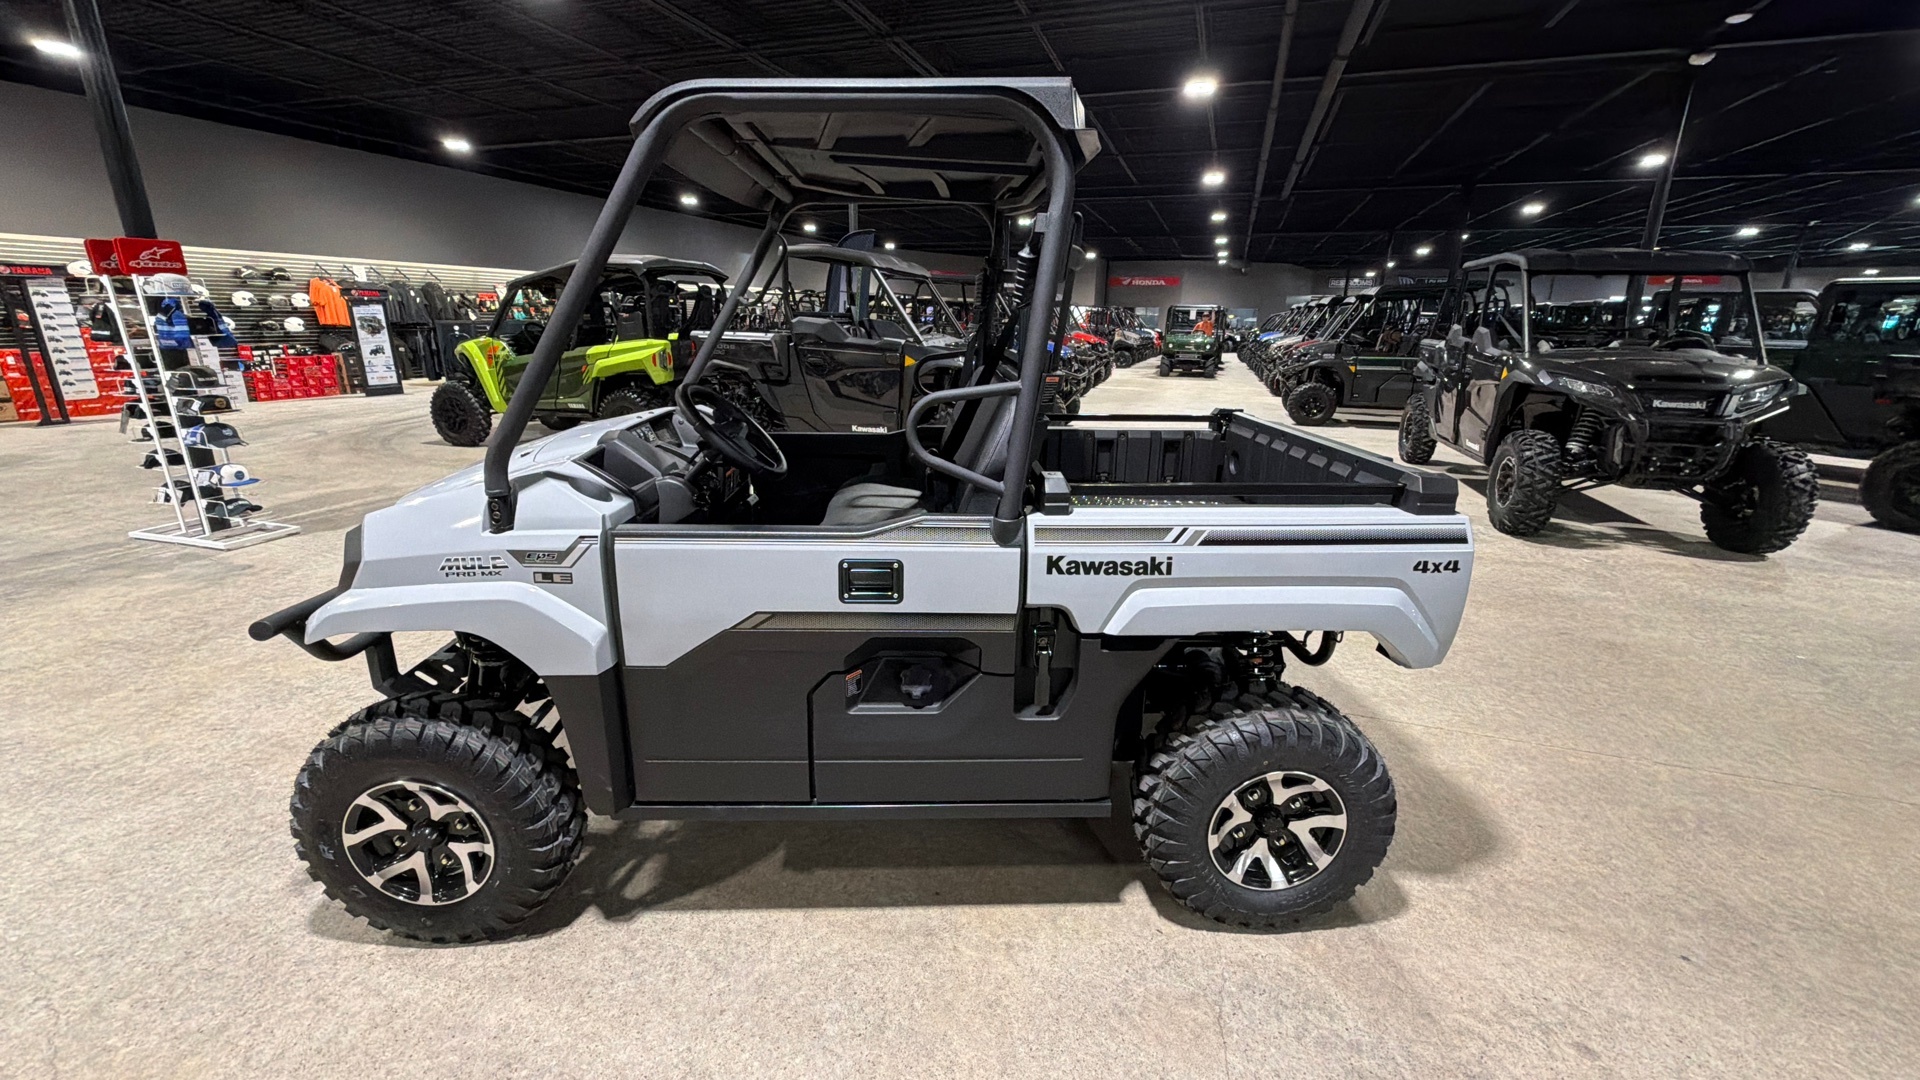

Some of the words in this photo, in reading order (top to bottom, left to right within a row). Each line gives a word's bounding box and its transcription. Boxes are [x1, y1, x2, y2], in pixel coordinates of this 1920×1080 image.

[1652, 399, 1707, 410] Kawasaki
[851, 424, 888, 434] Kawasaki
[438, 555, 510, 571] MULE
[1046, 555, 1173, 576] Kawasaki
[1412, 560, 1461, 574] 4x4
[534, 572, 573, 584] LE
